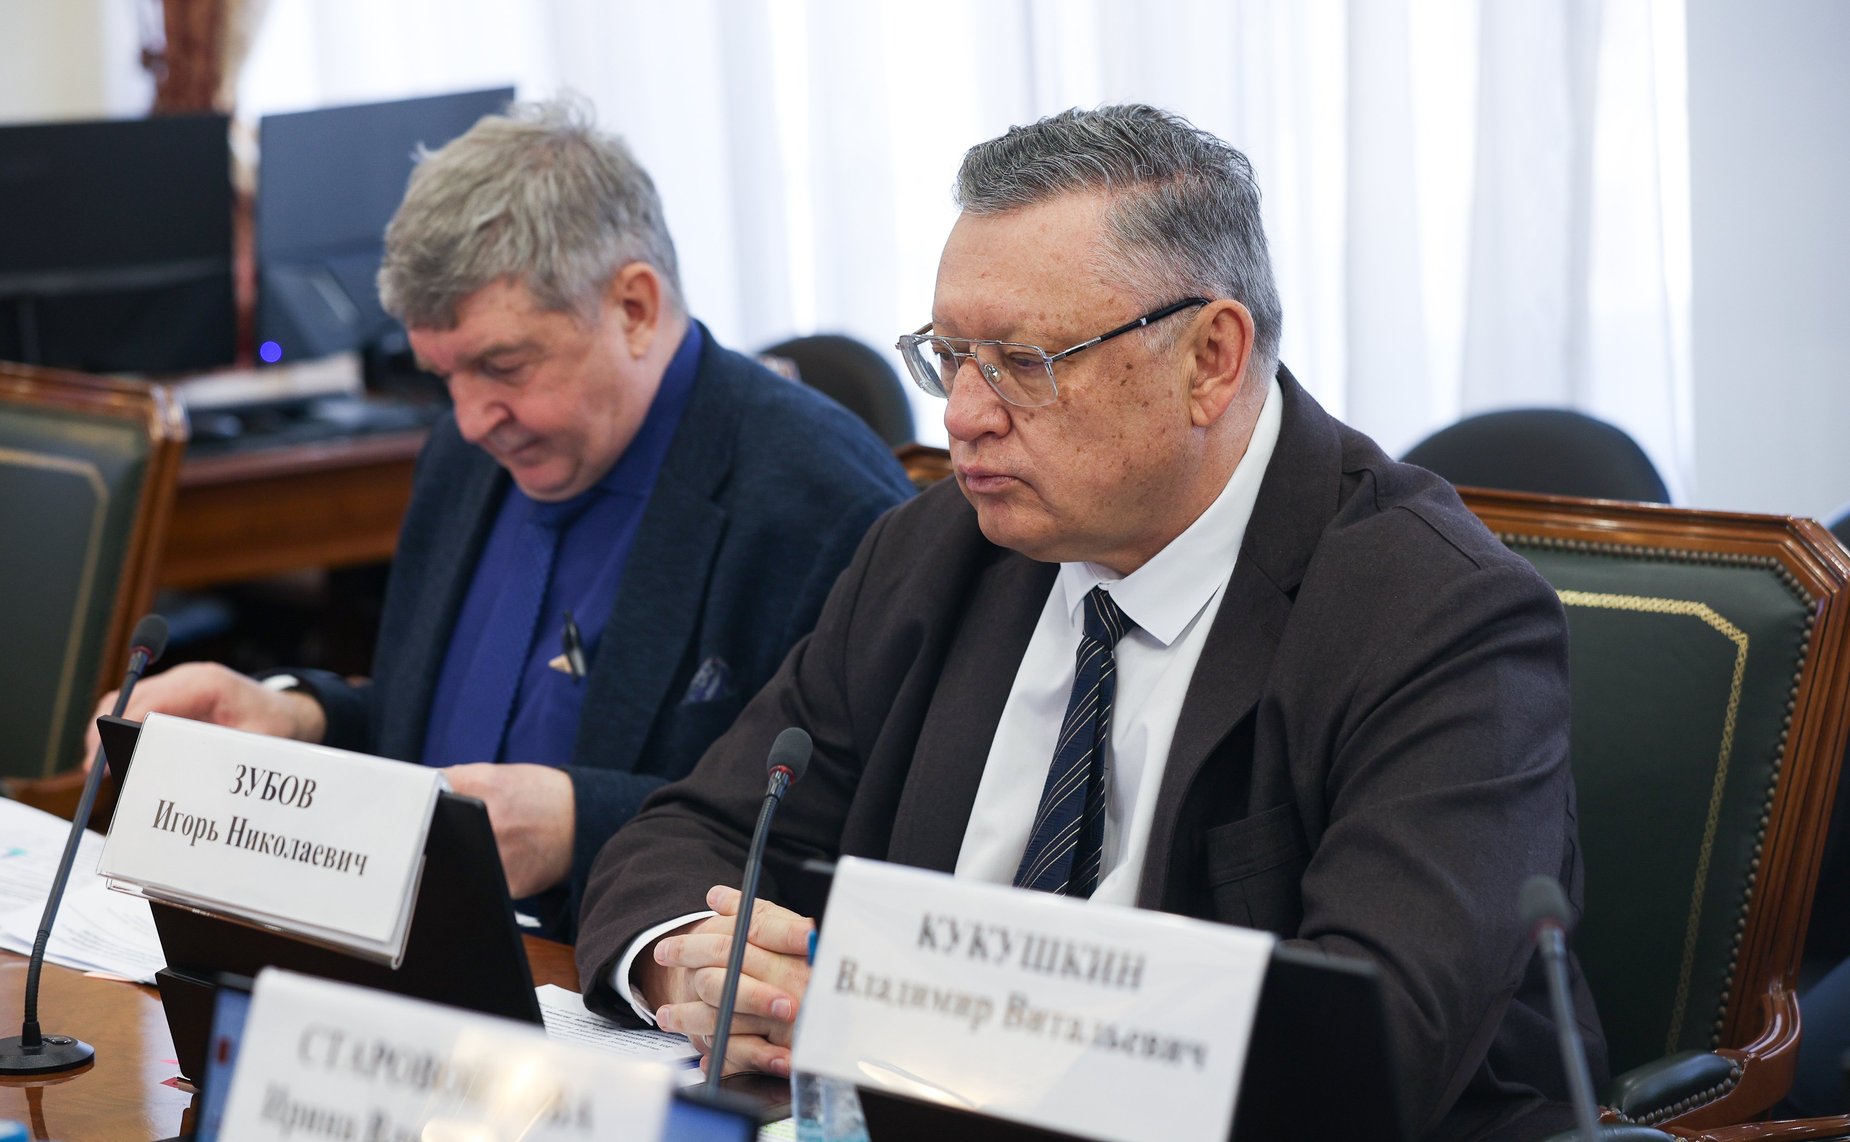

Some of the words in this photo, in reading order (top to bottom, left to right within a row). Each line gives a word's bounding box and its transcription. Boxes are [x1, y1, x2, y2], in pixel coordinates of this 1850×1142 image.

[229, 764, 317, 809] ЗУБОВ
[152, 799, 219, 846] Игорь
[226, 816, 369, 876] Николаевич
[916, 912, 1148, 990] КУКУШКИН
[834, 958, 995, 1031] Владимир
[1003, 992, 1209, 1071] Витальевич
